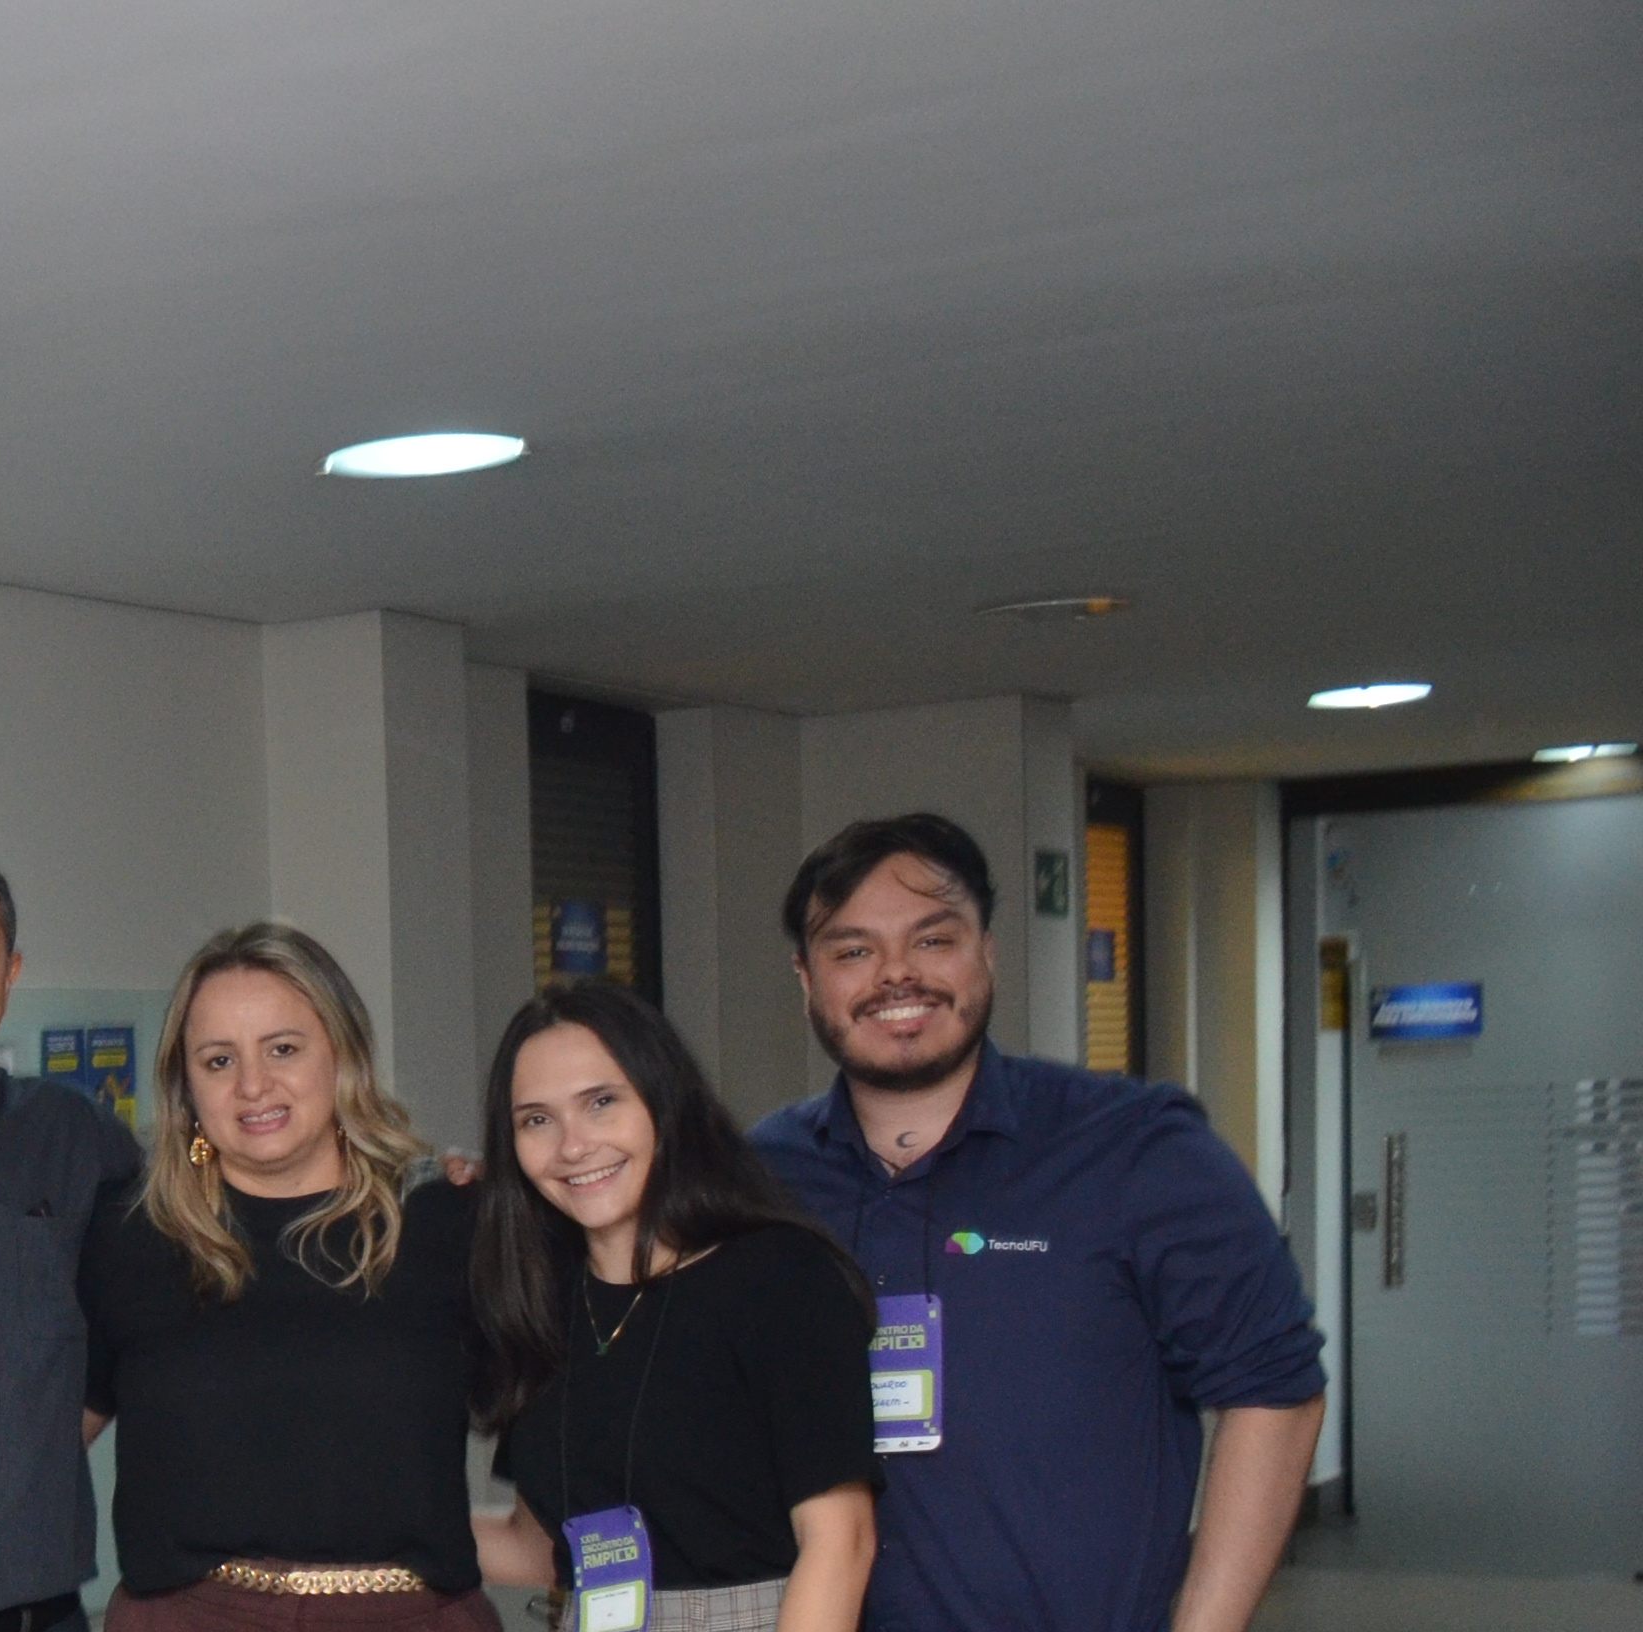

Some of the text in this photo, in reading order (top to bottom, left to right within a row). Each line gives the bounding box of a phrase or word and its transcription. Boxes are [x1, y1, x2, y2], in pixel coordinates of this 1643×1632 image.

[987, 1239, 1048, 1252] TecnoUFU
[869, 1336, 893, 1351] MPI
[583, 1550, 615, 1569] RMPI
